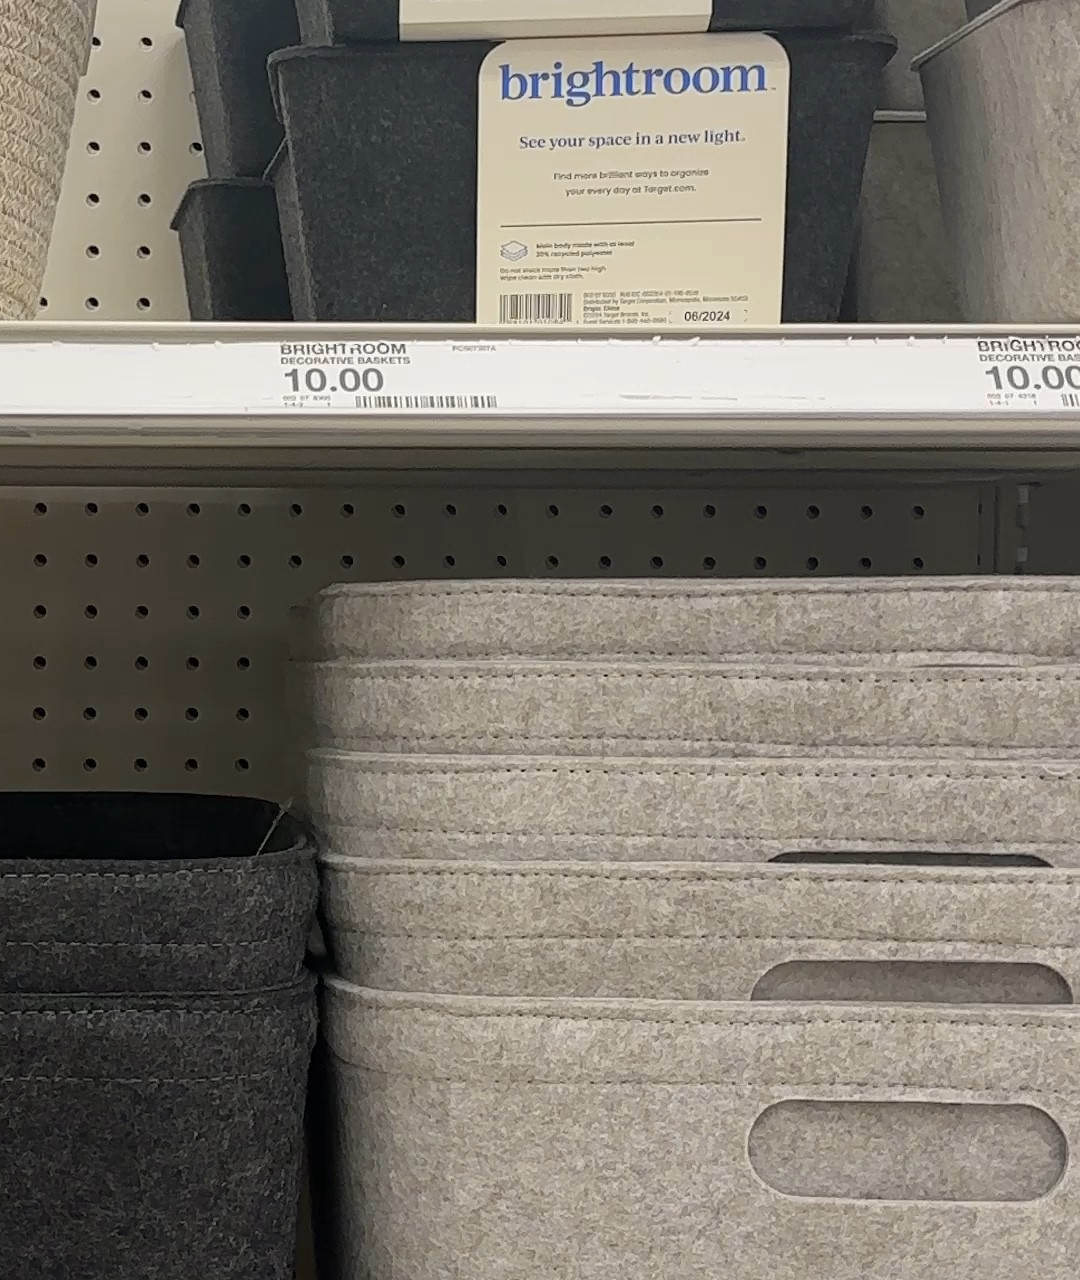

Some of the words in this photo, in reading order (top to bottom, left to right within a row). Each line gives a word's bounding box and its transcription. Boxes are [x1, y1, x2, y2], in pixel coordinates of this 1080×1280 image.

[498, 61, 768, 107] brightroom
[519, 135, 545, 149] See
[548, 135, 586, 151] your
[588, 133, 632, 149] space
[635, 131, 651, 146] in
[654, 134, 664, 145] a
[668, 132, 701, 145] new
[704, 129, 747, 146] light.
[553, 171, 572, 180] Find
[573, 172, 598, 180] more
[659, 169, 669, 177] to
[670, 168, 709, 179] organize
[565, 188, 585, 197] your
[587, 187, 611, 196] every
[613, 186, 631, 195] day
[632, 186, 642, 194] at
[684, 310, 731, 322] 06/2024
[280, 342, 407, 355] BRIGHTROOM
[280, 357, 354, 365] DECORATIVE
[358, 357, 410, 365] BASKETS
[979, 354, 1055, 362] DECORATIVE
[284, 368, 384, 392] 10.00
